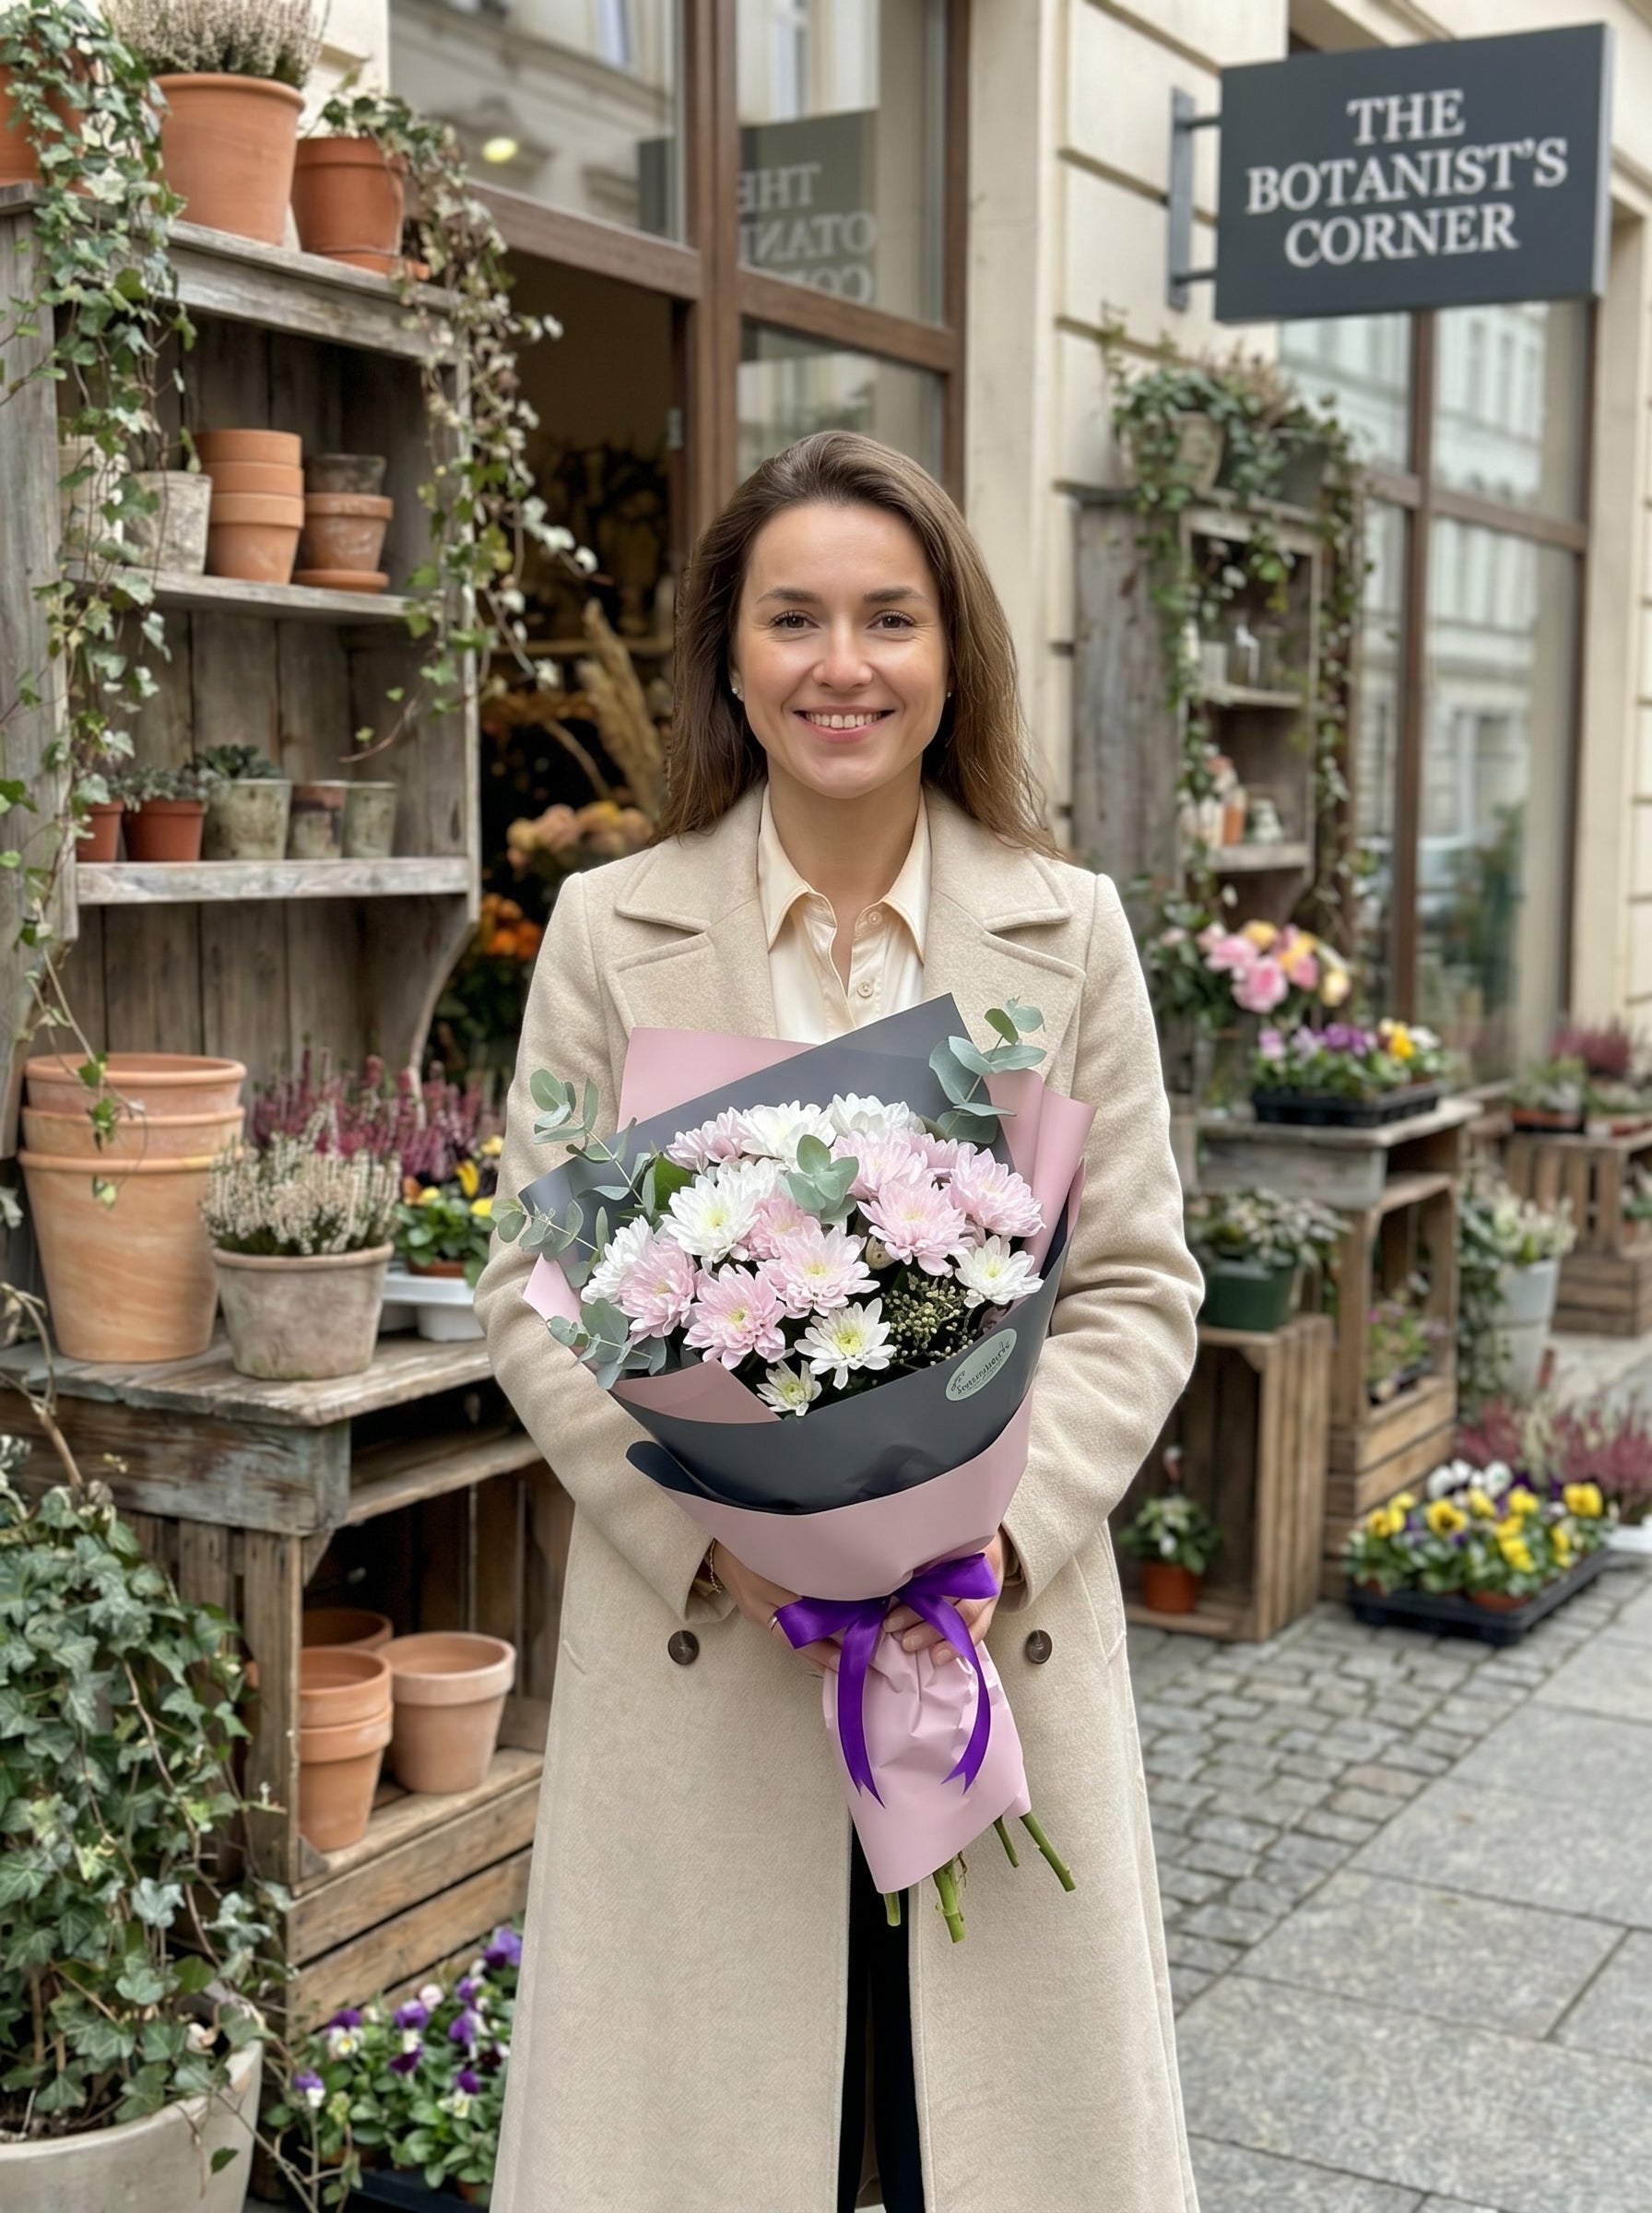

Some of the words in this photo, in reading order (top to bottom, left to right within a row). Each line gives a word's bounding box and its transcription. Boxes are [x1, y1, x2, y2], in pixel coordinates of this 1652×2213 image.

[1346, 88, 1466, 147] THE
[1245, 137, 1568, 216] BOTANIST'S
[1283, 202, 1521, 268] CORNER
